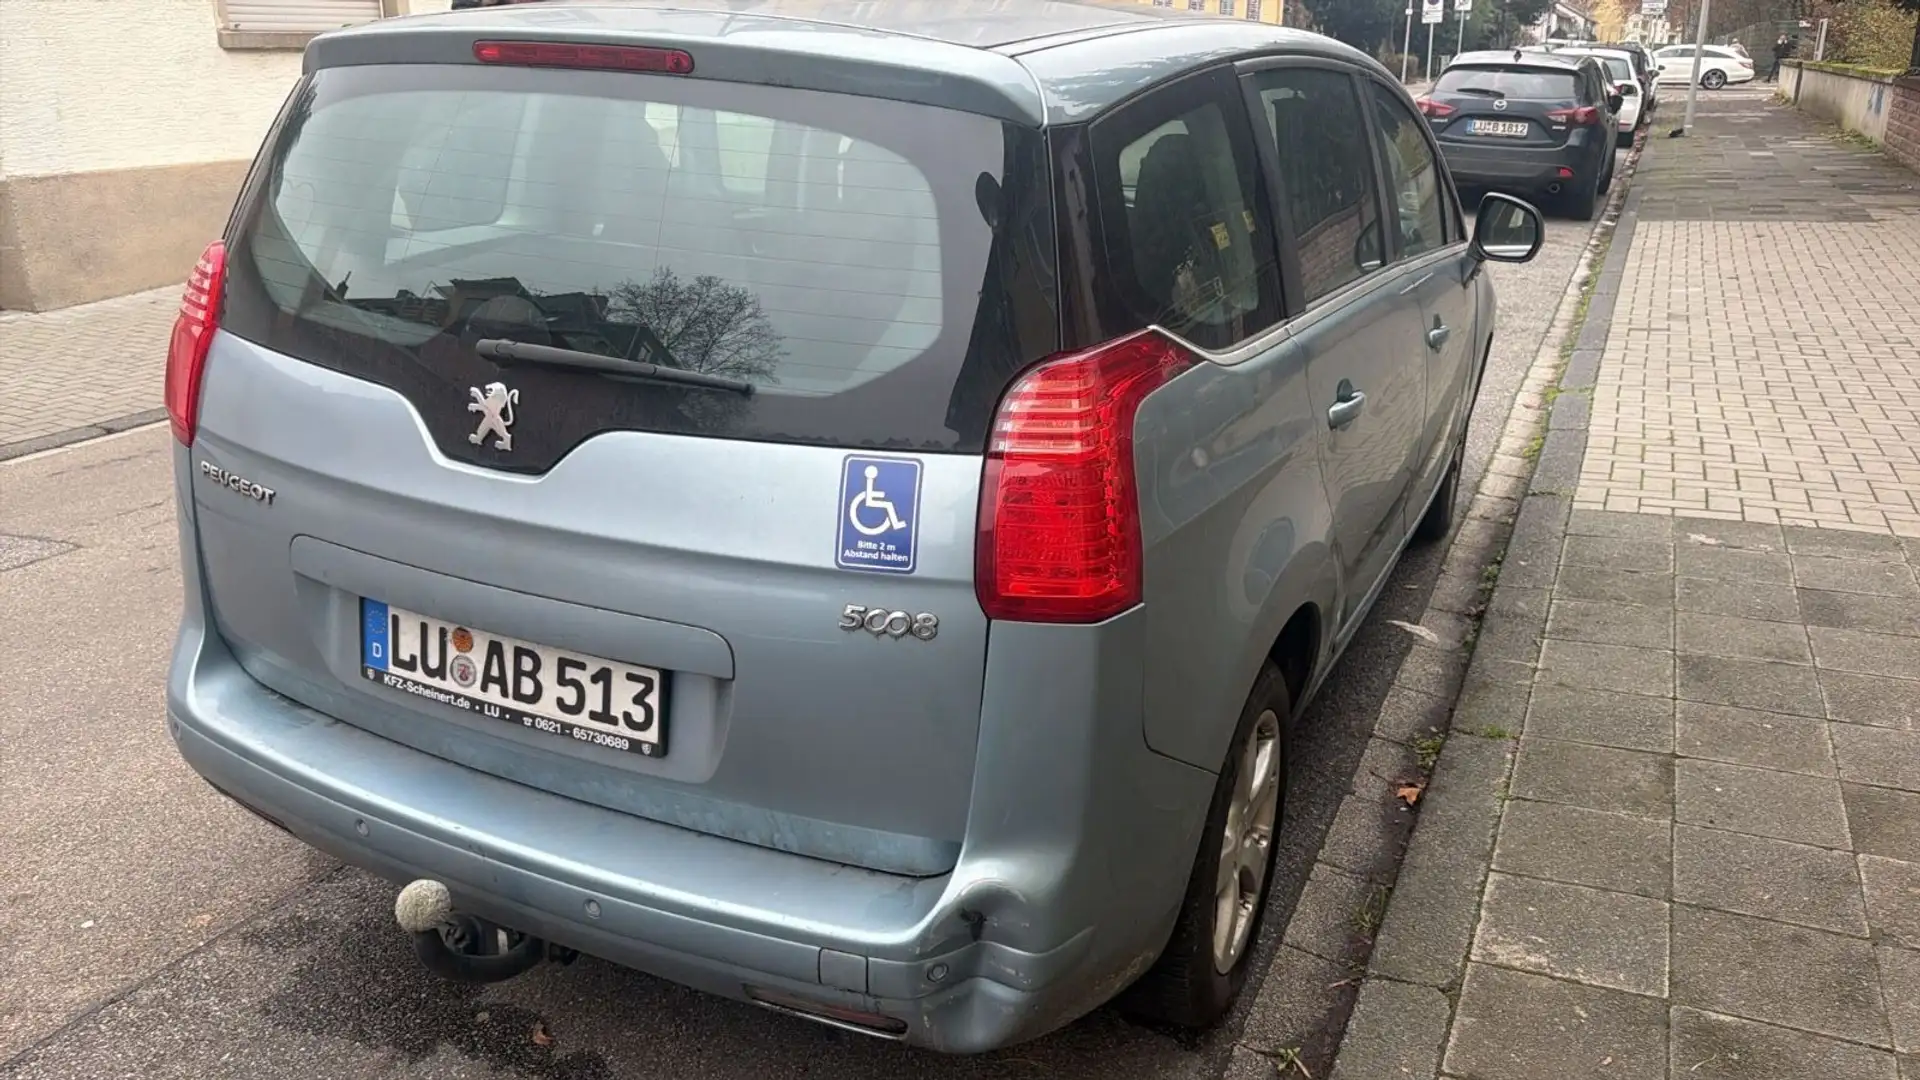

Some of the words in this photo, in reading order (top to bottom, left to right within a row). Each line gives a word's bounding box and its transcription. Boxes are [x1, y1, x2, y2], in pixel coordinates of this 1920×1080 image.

[1473, 121, 1486, 131] LU
[200, 460, 276, 506] PEUGEOT
[843, 549, 879, 560] Abstand
[880, 551, 909, 562] halten
[857, 540, 878, 550] Bitte
[879, 542, 886, 551] 2
[838, 603, 940, 640] 5008
[372, 642, 382, 658] D
[391, 613, 448, 681] LU
[479, 639, 543, 705] AB
[556, 656, 655, 732] 513
[383, 674, 471, 709] KFZ-Scheinert.de
[484, 704, 500, 718] LU
[535, 717, 561, 734] 0621
[573, 727, 629, 750] 65730689
